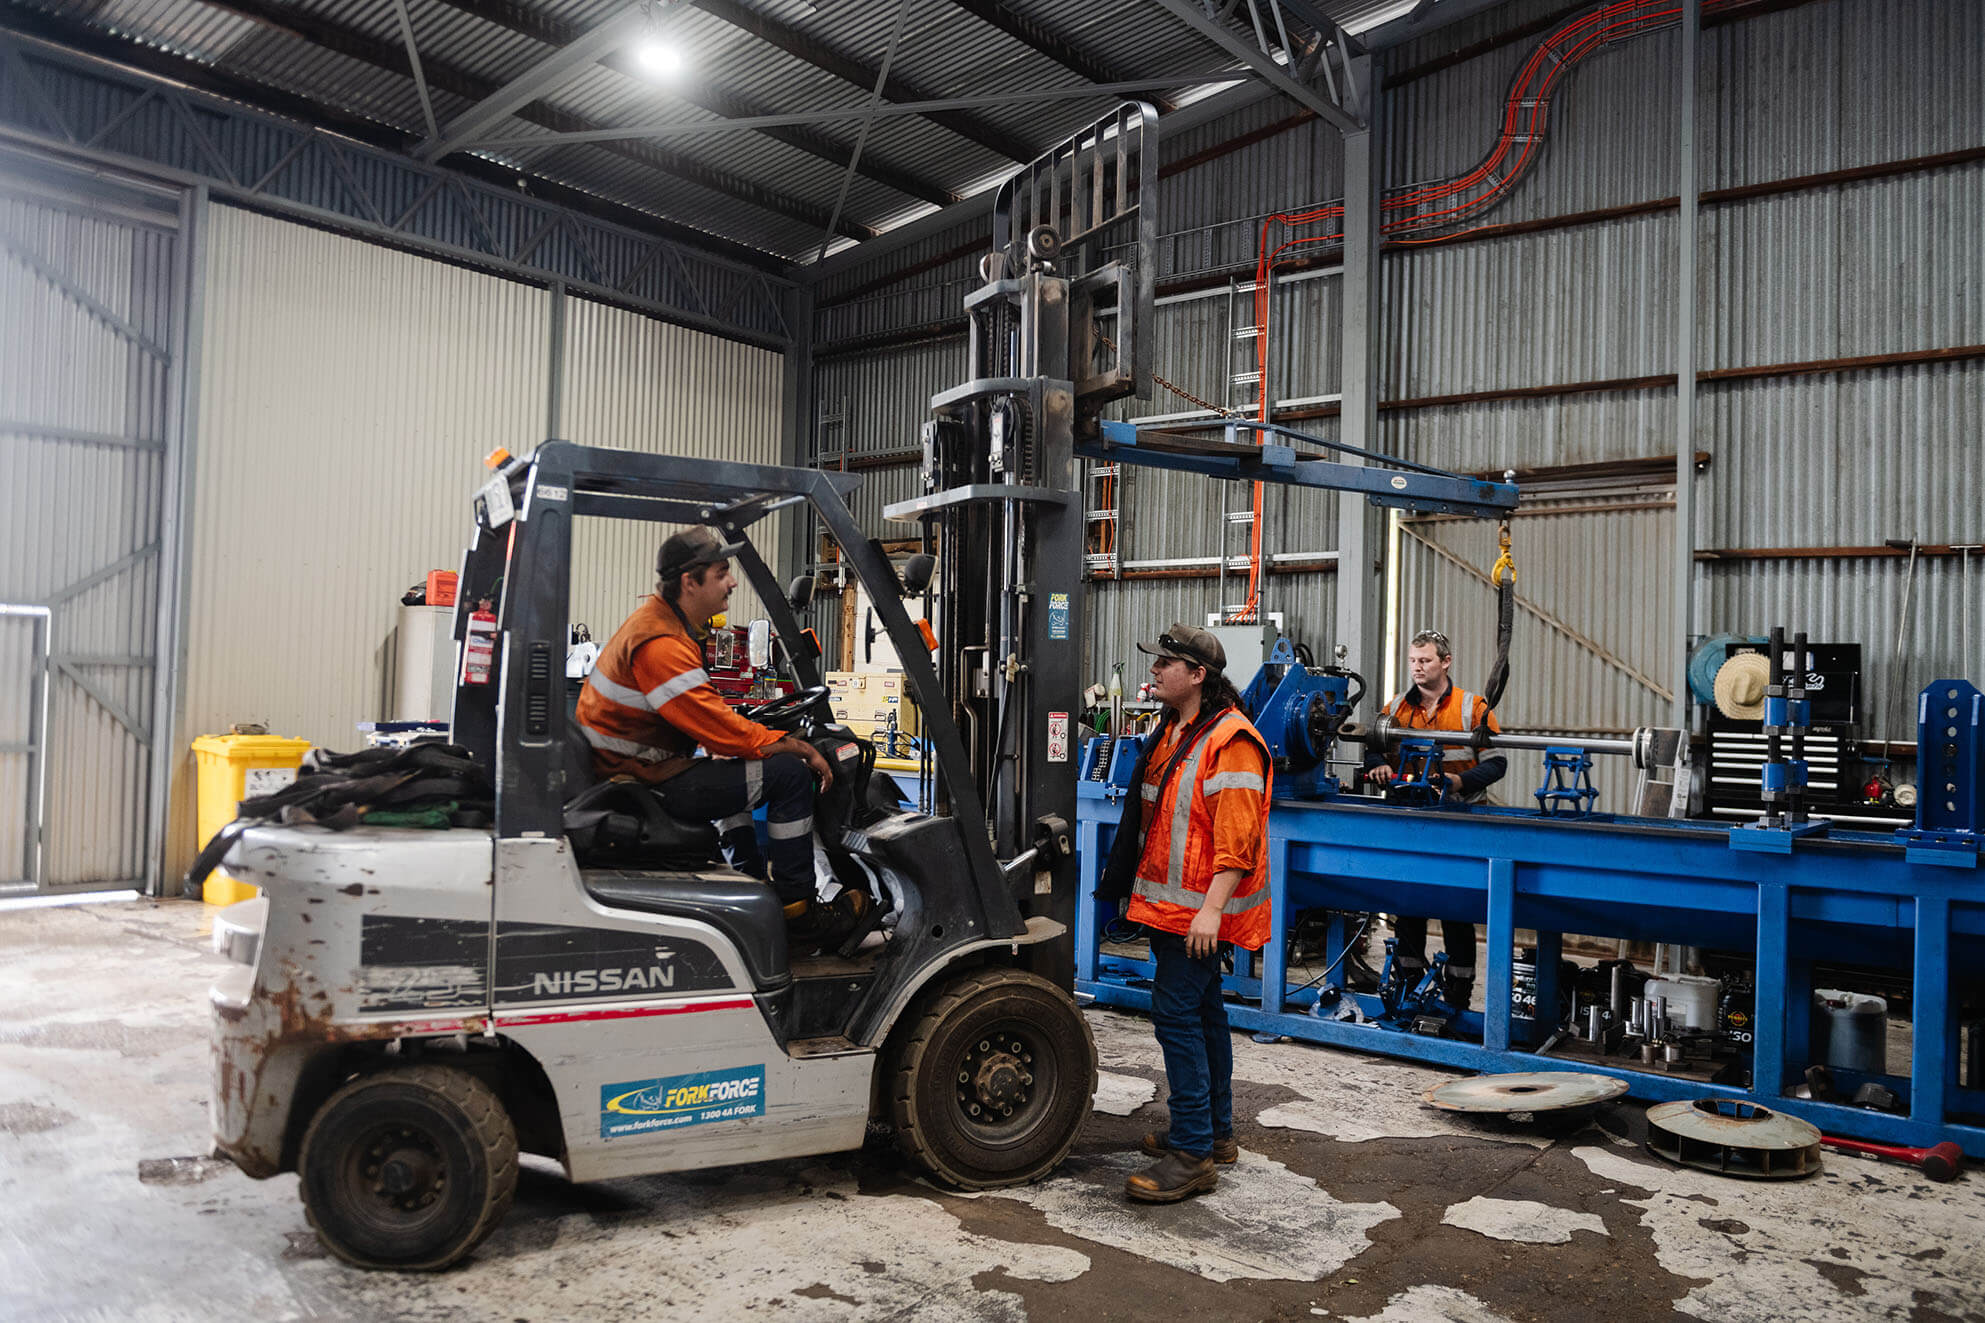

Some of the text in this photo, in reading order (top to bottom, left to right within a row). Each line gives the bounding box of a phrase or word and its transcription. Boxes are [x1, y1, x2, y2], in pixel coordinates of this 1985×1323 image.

[1049, 601, 1069, 610] FORCE
[1050, 593, 1068, 601] FORK
[534, 965, 674, 995] NISSAN
[610, 1105, 757, 1133] www.forkforce.com 1300 4A FORK
